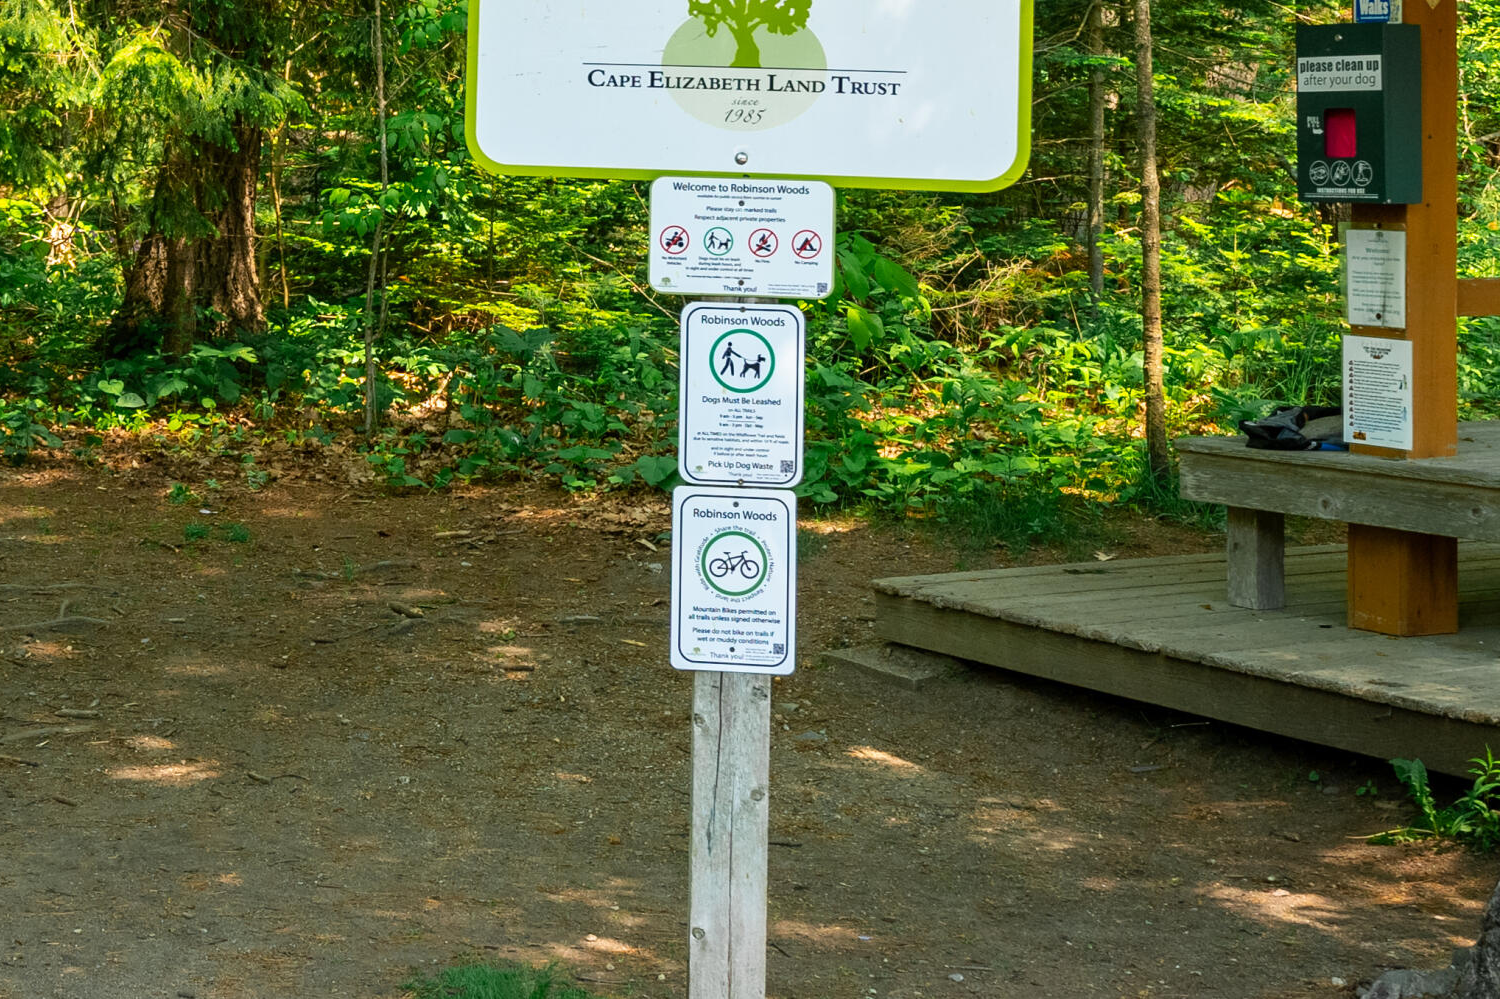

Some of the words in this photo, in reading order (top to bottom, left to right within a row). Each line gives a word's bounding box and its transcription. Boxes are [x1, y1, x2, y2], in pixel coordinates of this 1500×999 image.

[1359, 0, 1388, 16] Walks
[1300, 60, 1333, 73] please
[1335, 60, 1364, 72] clean
[1366, 60, 1379, 72] up
[1303, 74, 1327, 86] after
[1329, 75, 1352, 88] your
[1355, 73, 1376, 87] dog
[731, 97, 760, 107] since
[724, 107, 767, 125] 1985
[673, 182, 716, 192] Welcome
[718, 184, 728, 192] to
[731, 184, 775, 194] Robinson
[777, 185, 810, 195] Woods
[701, 315, 748, 326] Robinson
[750, 317, 785, 327] Woods
[702, 396, 720, 404] Dogs
[724, 461, 734, 469] Up
[735, 462, 751, 470] Dog
[752, 462, 773, 470] Waste
[693, 508, 740, 519] Robinson
[743, 511, 777, 521] Woods
[714, 525, 732, 534] Share
[744, 527, 756, 536] trail
[710, 651, 729, 659] Thank
